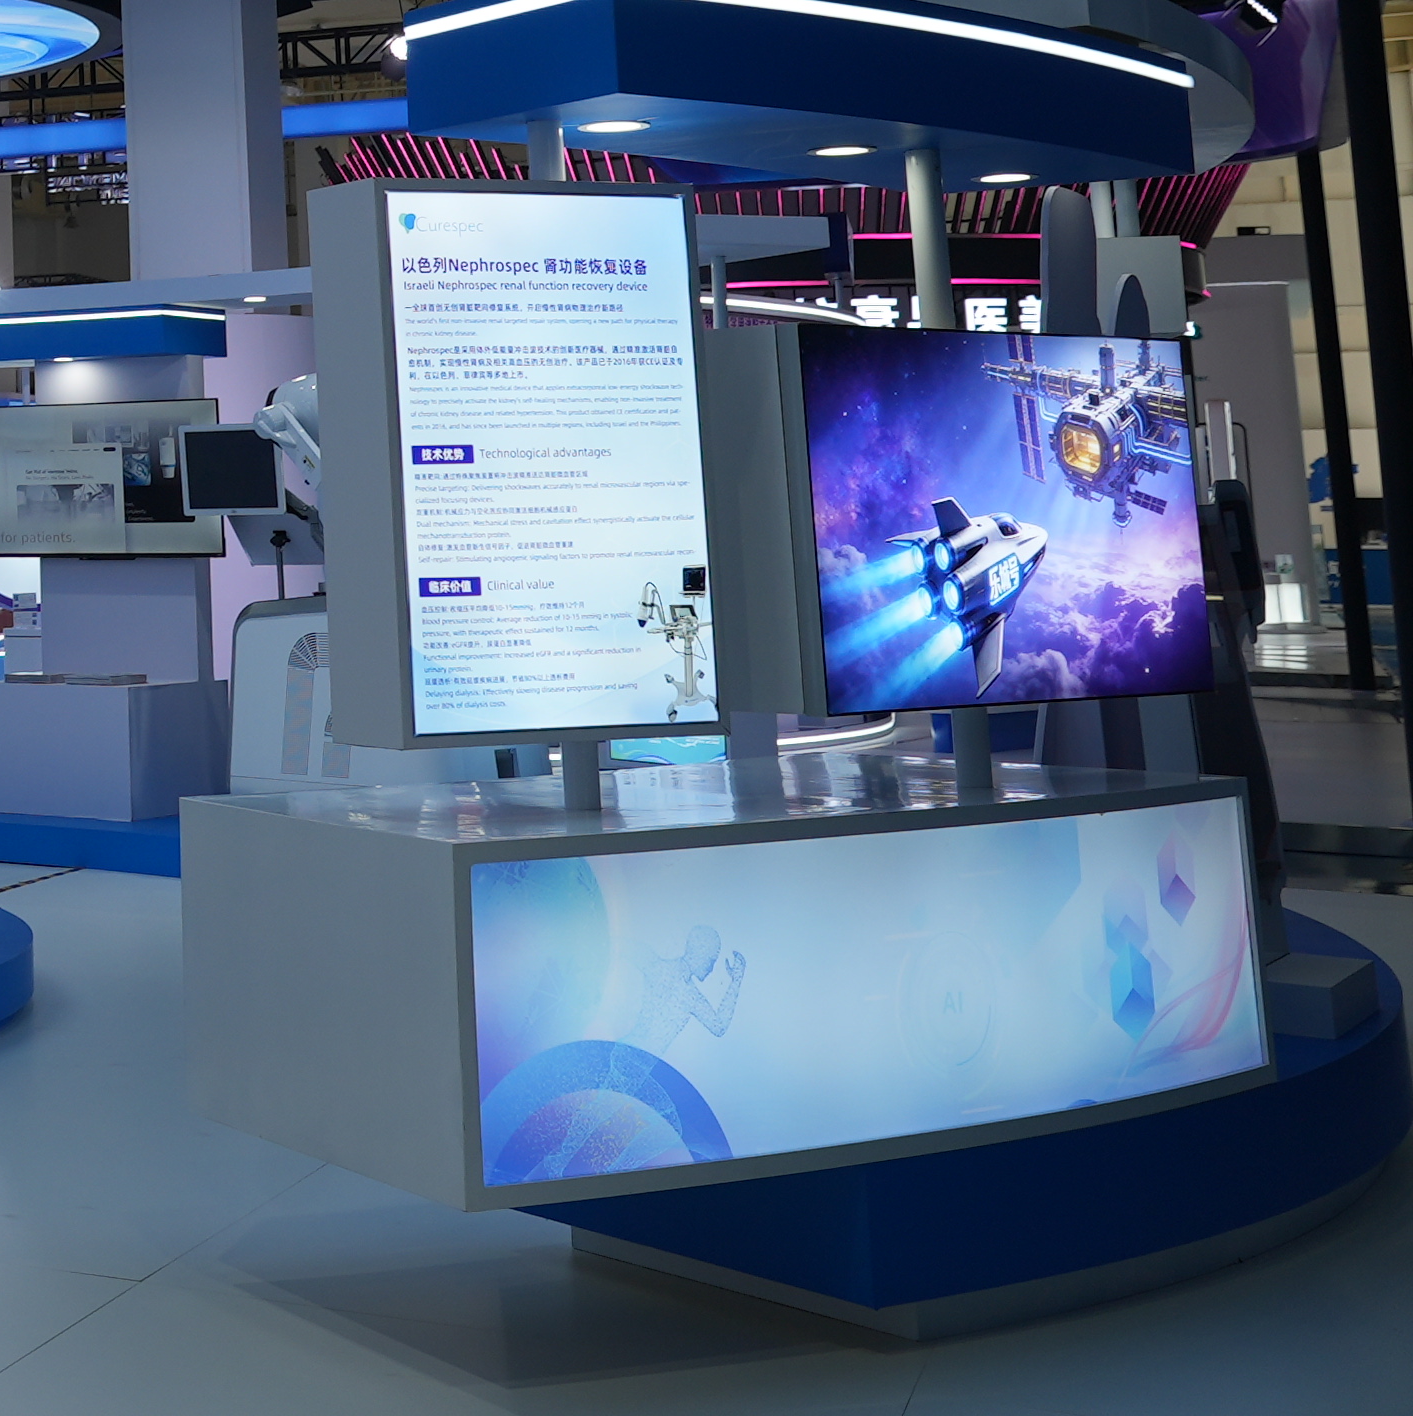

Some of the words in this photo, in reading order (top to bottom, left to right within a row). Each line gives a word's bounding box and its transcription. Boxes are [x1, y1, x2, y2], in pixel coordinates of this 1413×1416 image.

[414, 215, 483, 236] Curespec
[402, 256, 539, 275] 以色列Nephrospec
[544, 258, 648, 276] 肾功能恢复设备
[403, 280, 434, 290] Israeli
[437, 280, 497, 291] Nephrospec
[500, 280, 526, 289] renal
[528, 280, 569, 290] function
[571, 283, 614, 292] recovery
[615, 281, 647, 291] device
[421, 448, 465, 461] 技术优势
[479, 448, 550, 460] Technological
[552, 446, 611, 459] advantages
[1, 532, 18, 543] for
[21, 531, 76, 546] patients.
[428, 580, 472, 593] 临床价值
[487, 579, 523, 590] Clinical
[525, 579, 554, 589] value
[942, 992, 964, 1014] AI
